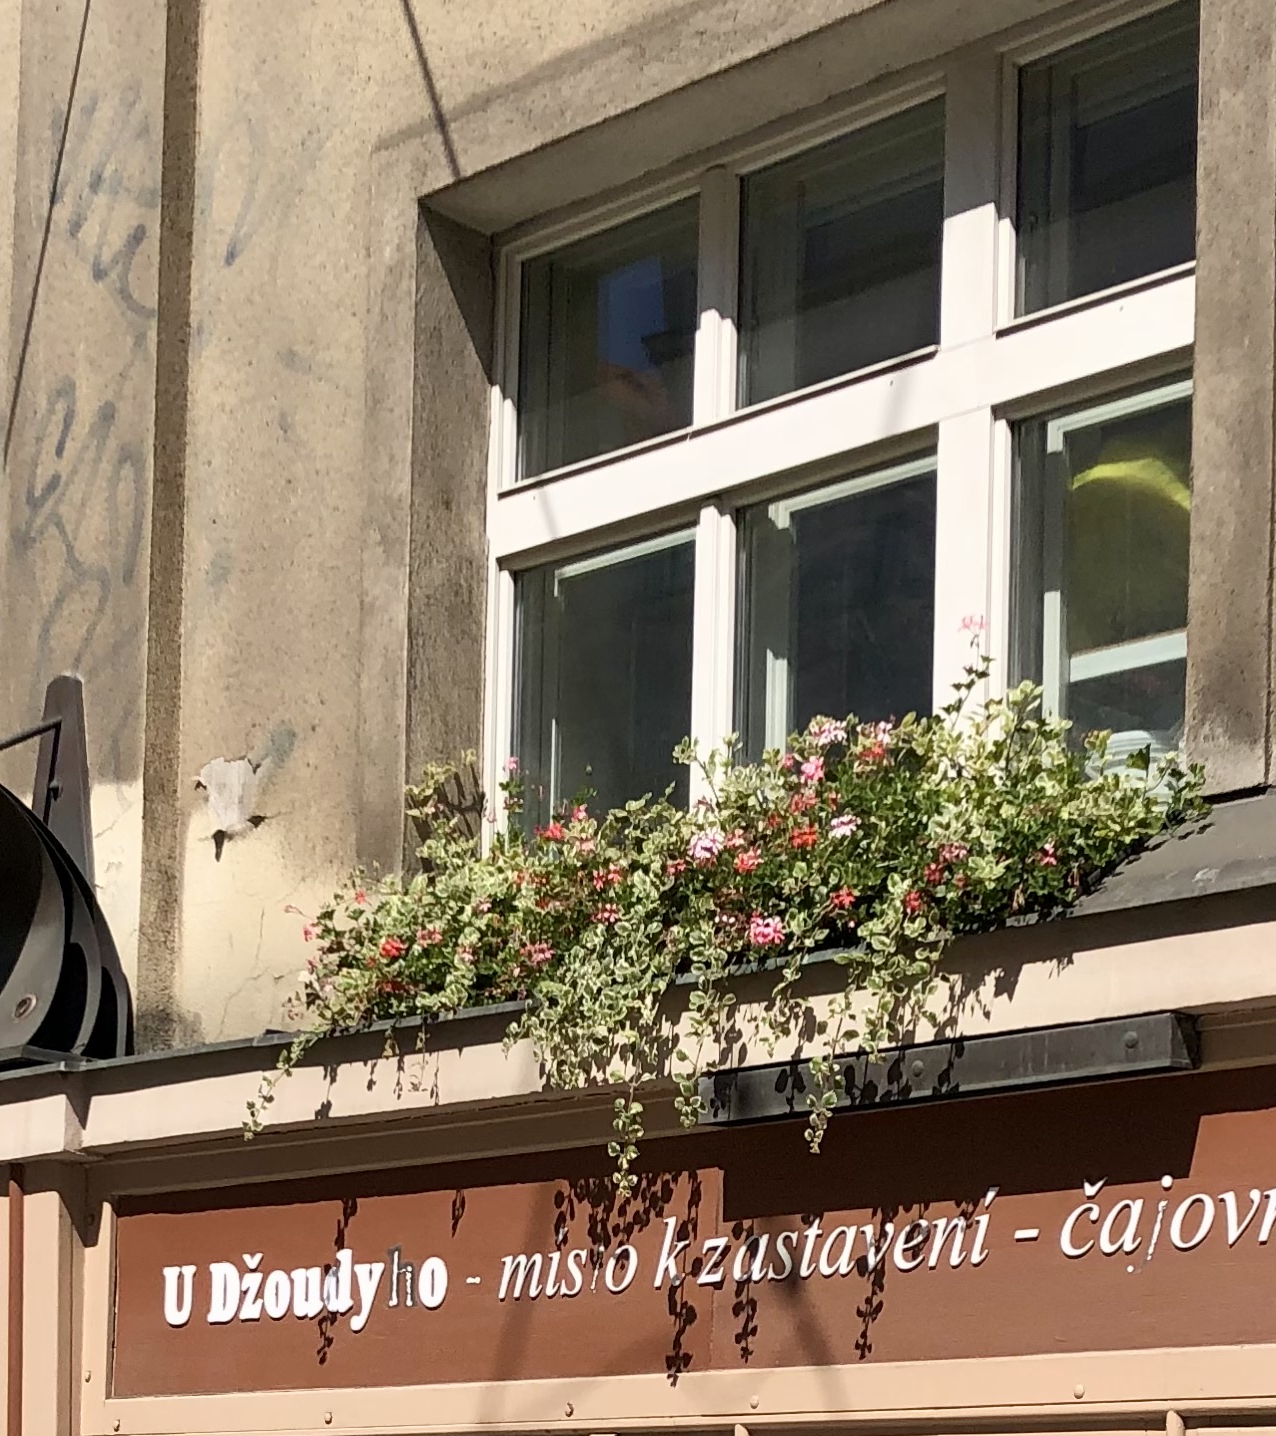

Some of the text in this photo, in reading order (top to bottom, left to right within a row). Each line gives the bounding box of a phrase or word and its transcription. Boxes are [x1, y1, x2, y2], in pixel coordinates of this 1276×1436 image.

[162, 1264, 197, 1326] U
[206, 1244, 448, 1331] Džoudyho
[654, 1216, 681, 1289] k
[695, 1186, 999, 1285] zastavení
